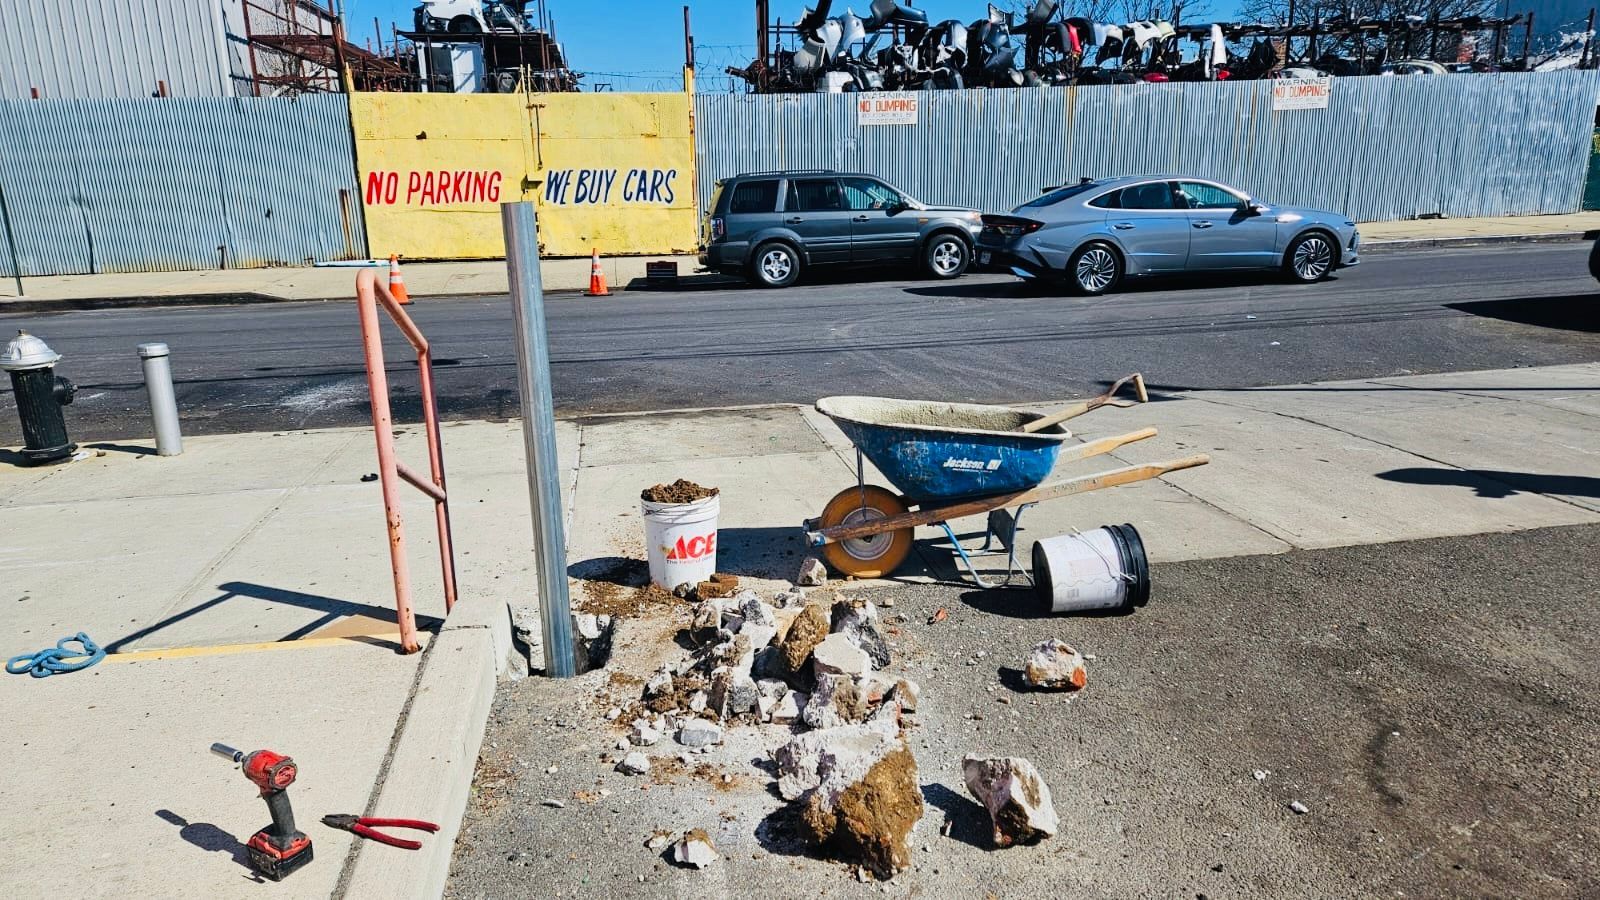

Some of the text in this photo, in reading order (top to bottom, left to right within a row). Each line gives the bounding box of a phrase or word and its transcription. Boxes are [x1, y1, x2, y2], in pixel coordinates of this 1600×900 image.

[1278, 78, 1327, 86] WARNING
[1275, 85, 1327, 98] NO DUMPING
[859, 99, 917, 112] NO DUMPING
[366, 170, 502, 206] NO PARKING
[545, 169, 677, 205] WE BUY CARS
[943, 456, 984, 469] Jackson
[666, 531, 716, 560] ACE
